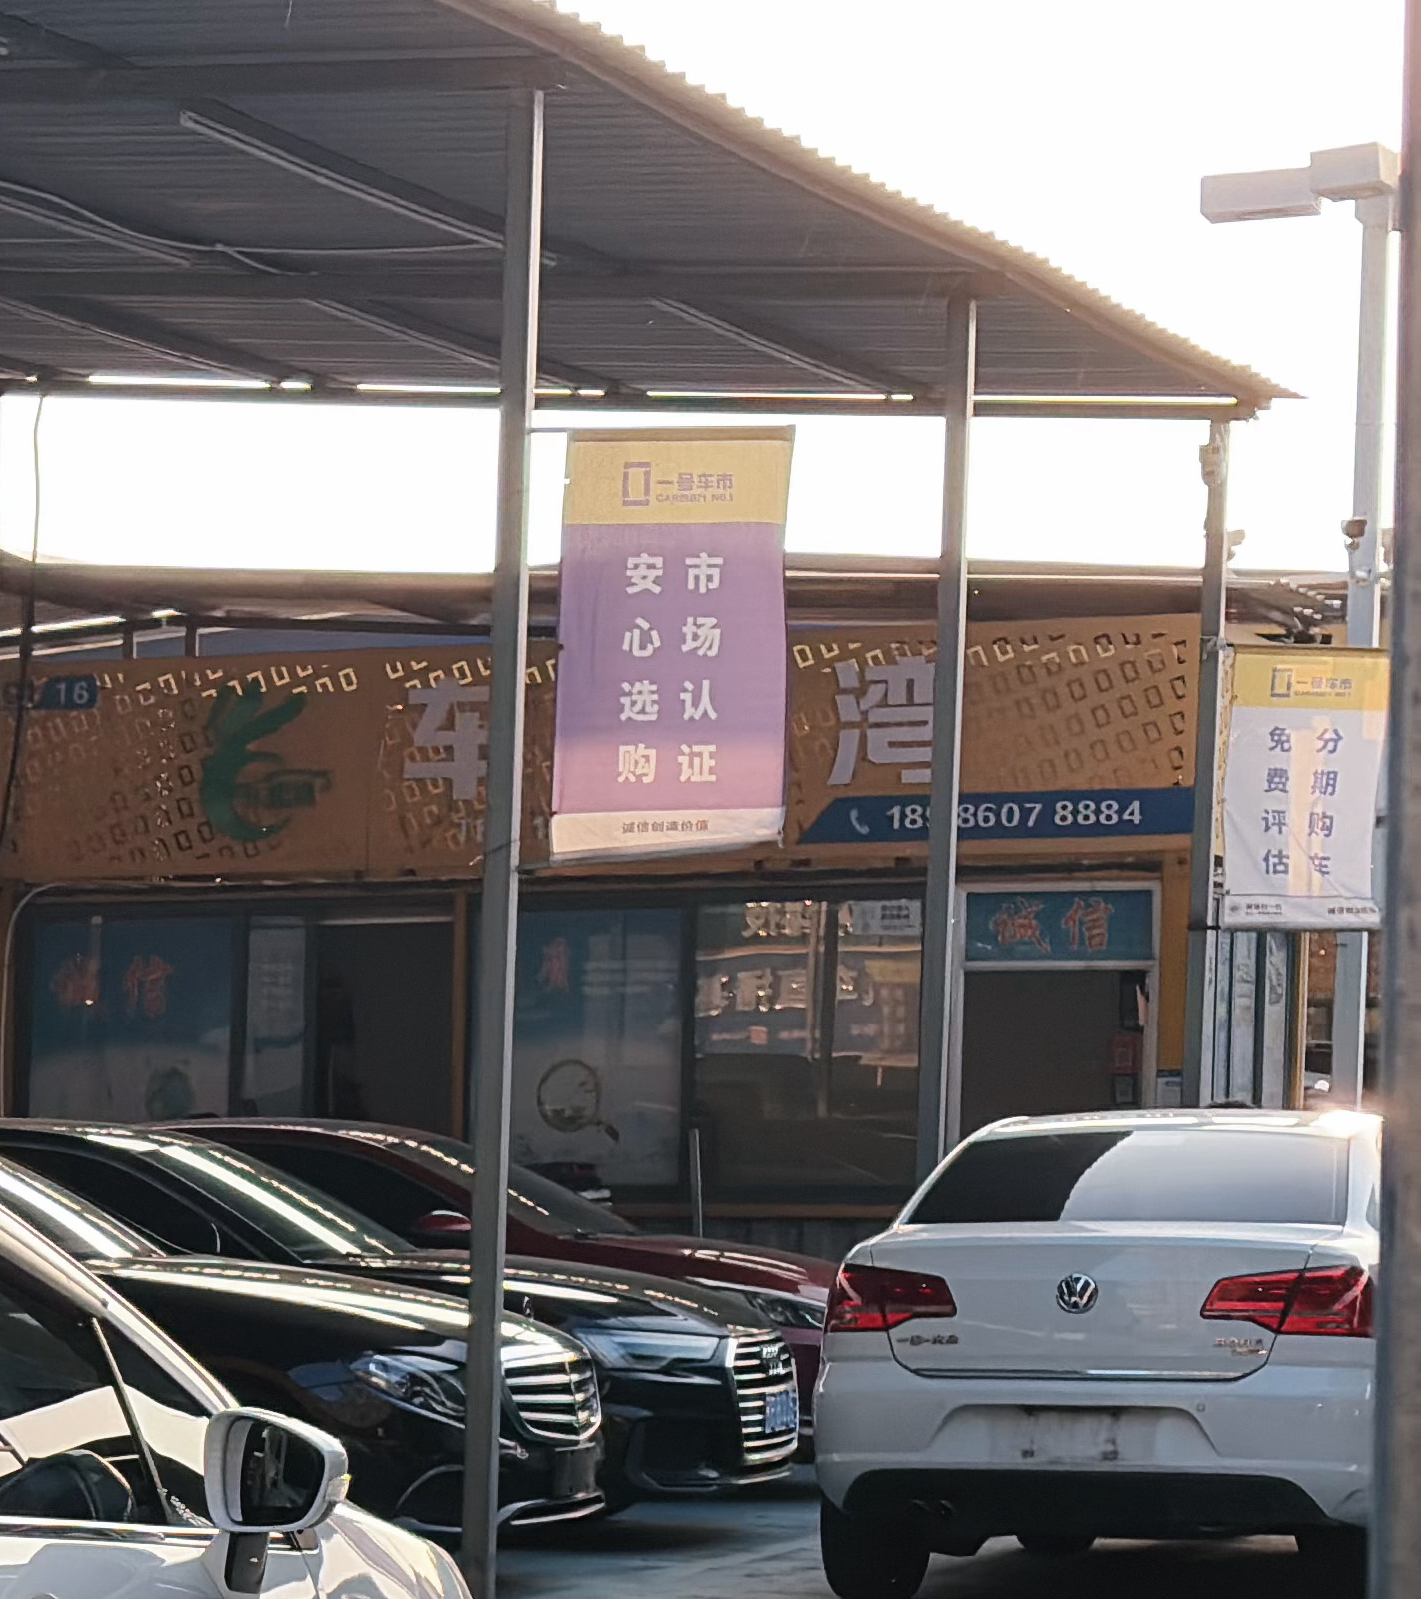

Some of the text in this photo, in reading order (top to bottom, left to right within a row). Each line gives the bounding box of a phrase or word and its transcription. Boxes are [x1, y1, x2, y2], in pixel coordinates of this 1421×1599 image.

[617, 552, 663, 784] 安心选购
[677, 552, 724, 784] 市场认证
[1054, 800, 1142, 826] 8884
[1262, 726, 1292, 876] 免费评估
[1308, 728, 1343, 877] 分期购车
